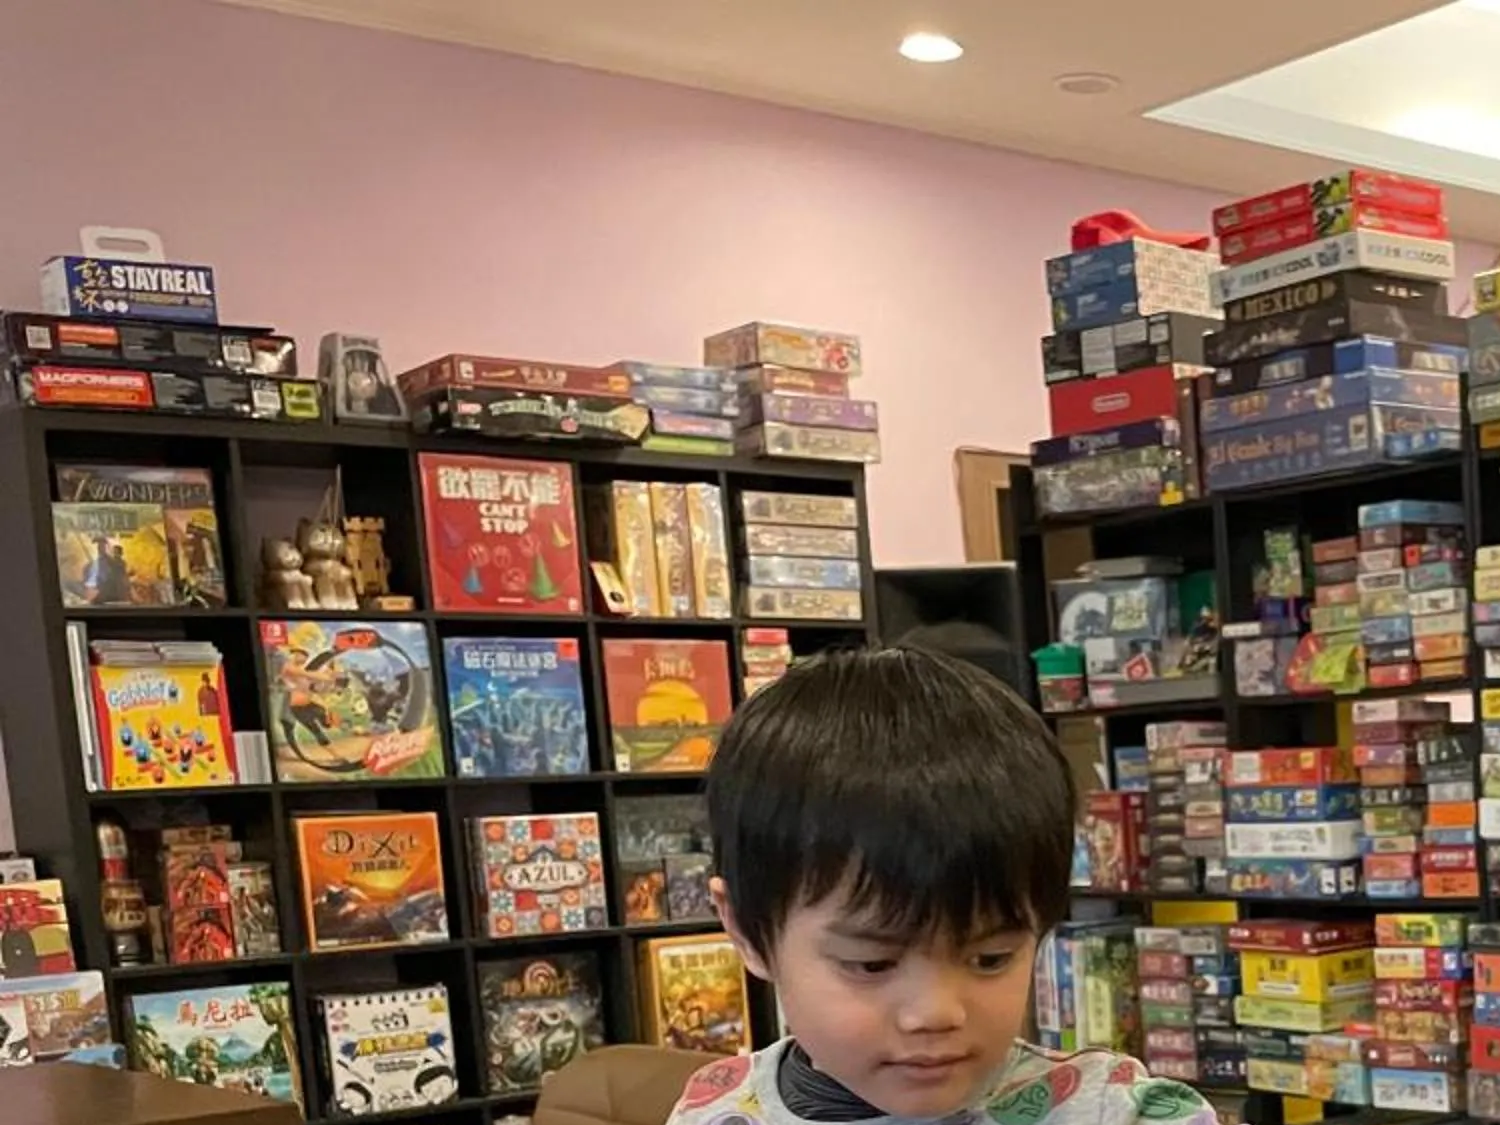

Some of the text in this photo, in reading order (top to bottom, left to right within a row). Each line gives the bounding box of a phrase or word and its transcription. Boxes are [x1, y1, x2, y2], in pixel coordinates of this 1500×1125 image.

[111, 265, 212, 295] STAYREAL
[1242, 282, 1319, 320] MEXICO
[480, 517, 529, 535] STOP
[518, 863, 575, 884] AZUL
